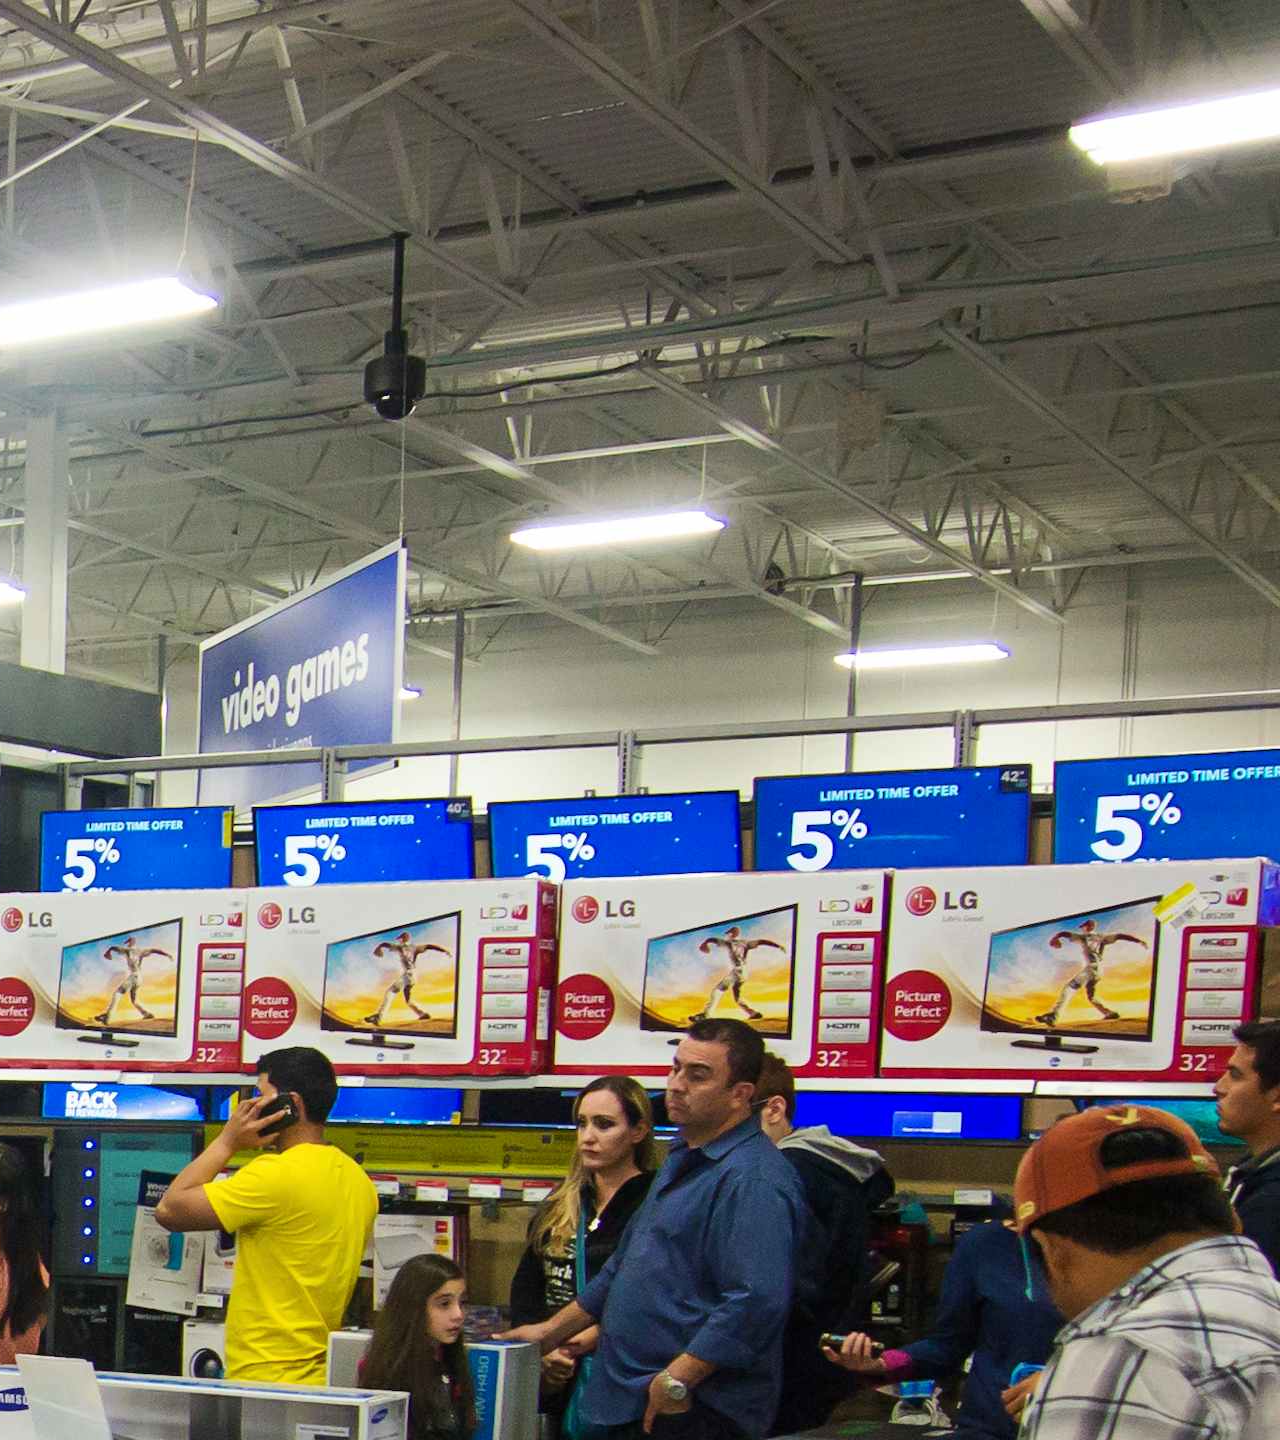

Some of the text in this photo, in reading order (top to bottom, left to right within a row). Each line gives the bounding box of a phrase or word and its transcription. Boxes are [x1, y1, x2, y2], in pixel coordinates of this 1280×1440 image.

[221, 631, 369, 734] video games
[1127, 771, 1188, 786] LIMITED
[1193, 768, 1228, 782] TIME
[819, 784, 959, 802] LIMITED TIME OFFER
[86, 820, 183, 832] LIMITED TIME OFFER
[305, 814, 414, 829] LIMITED TIME OFFER
[550, 811, 672, 827] LIMITED TIME OFFER
[1090, 791, 1181, 861] 5%
[786, 808, 868, 873] 5%
[62, 838, 120, 890] 5%
[282, 833, 346, 887] 5%
[523, 832, 596, 884] 5%
[606, 900, 635, 918] LG
[944, 891, 978, 910] LG
[28, 912, 52, 928] LG
[288, 907, 315, 924] LG
[251, 995, 289, 1005] Picture
[564, 992, 605, 1005] Picture
[895, 990, 941, 1003] Picture
[251, 1008, 289, 1019] Perfect
[563, 1006, 606, 1018] Perfect
[894, 1005, 941, 1018] Perfect
[66, 1091, 118, 1109] BACK
